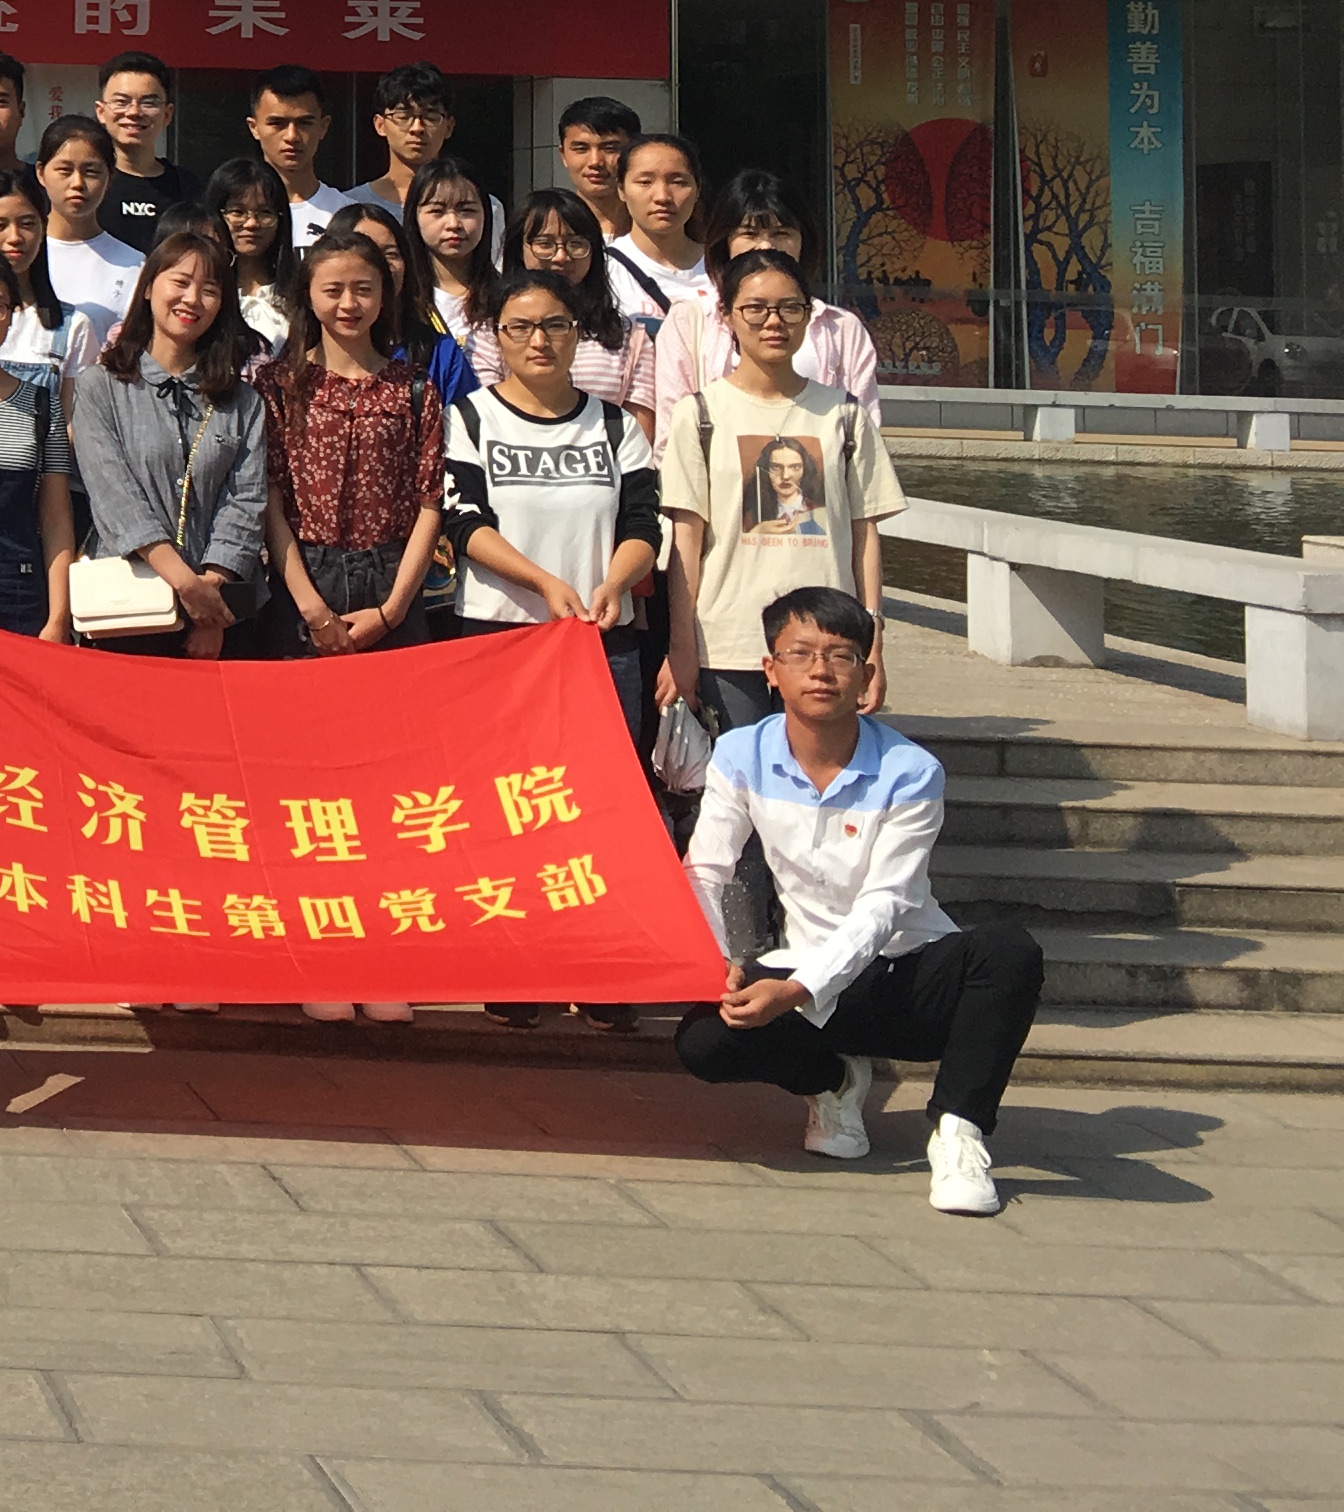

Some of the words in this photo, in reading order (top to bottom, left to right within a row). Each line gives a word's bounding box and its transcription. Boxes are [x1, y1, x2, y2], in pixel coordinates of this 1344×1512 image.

[1125, 1, 1164, 155] 勤善为本
[121, 201, 156, 216] NYC
[491, 444, 609, 478] STAGE
[741, 536, 757, 546] HAS
[788, 537, 799, 547] TO
